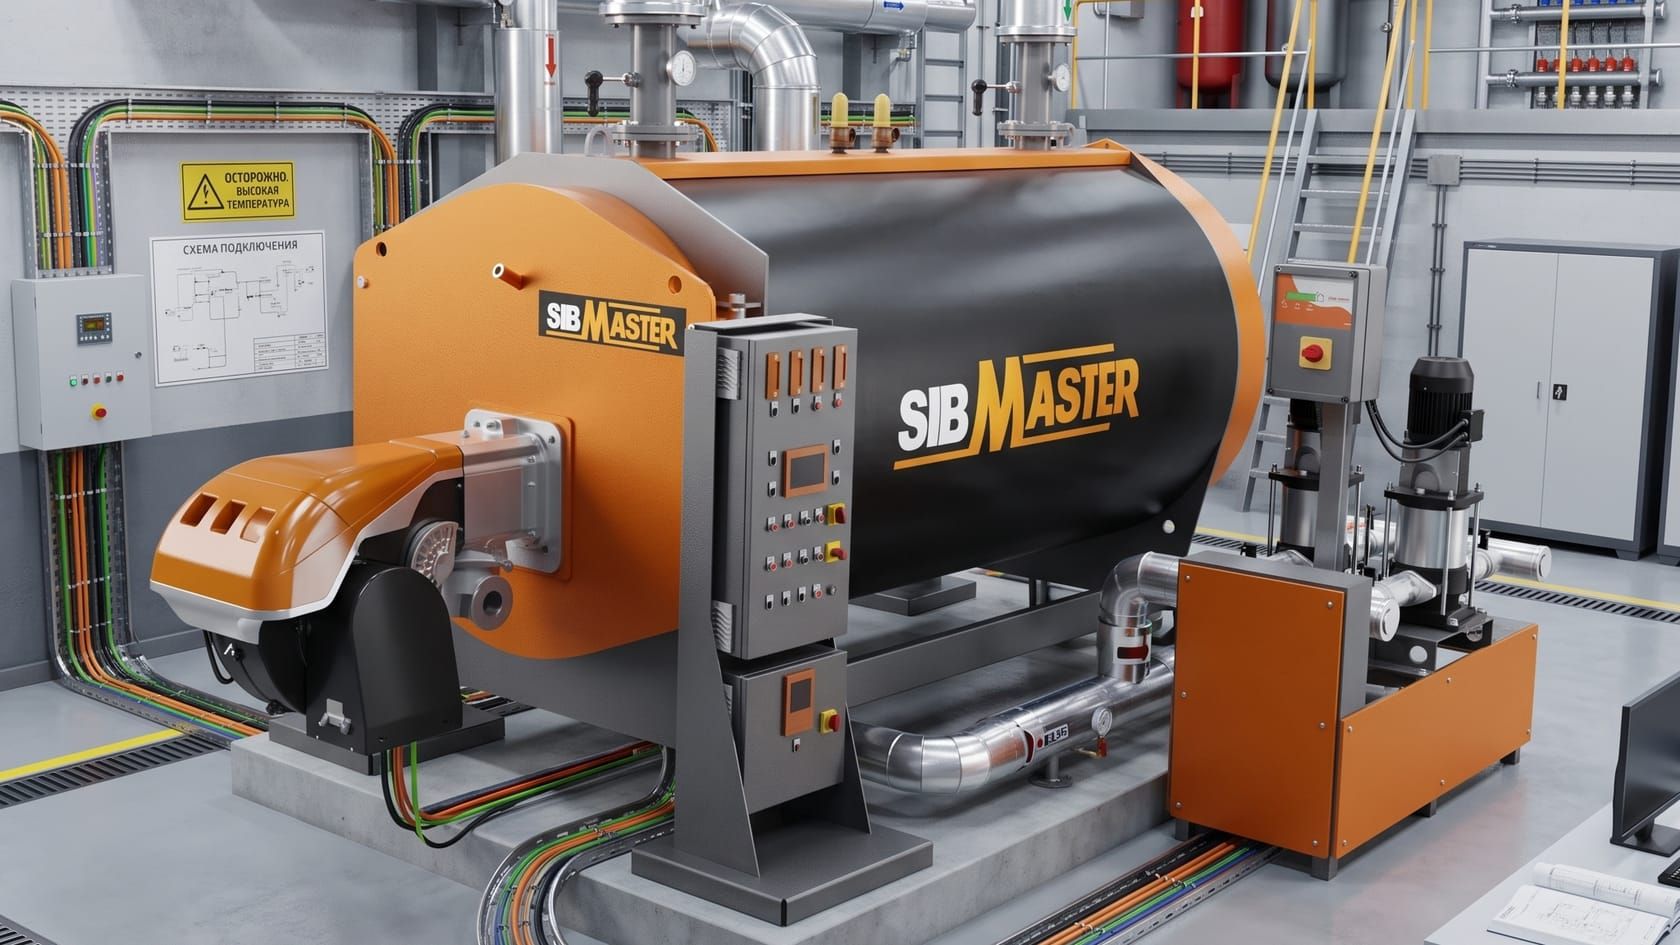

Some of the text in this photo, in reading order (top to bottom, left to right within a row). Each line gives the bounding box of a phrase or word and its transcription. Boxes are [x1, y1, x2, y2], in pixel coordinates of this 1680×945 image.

[224, 171, 289, 183] ОСТОРОЖНО.
[236, 185, 279, 196] ВЫСОКАЯ
[226, 198, 290, 209] ТЕМПЕРАТУРА
[183, 240, 298, 255] СХЕМА ПОДКЛЮЧЕНИЯ
